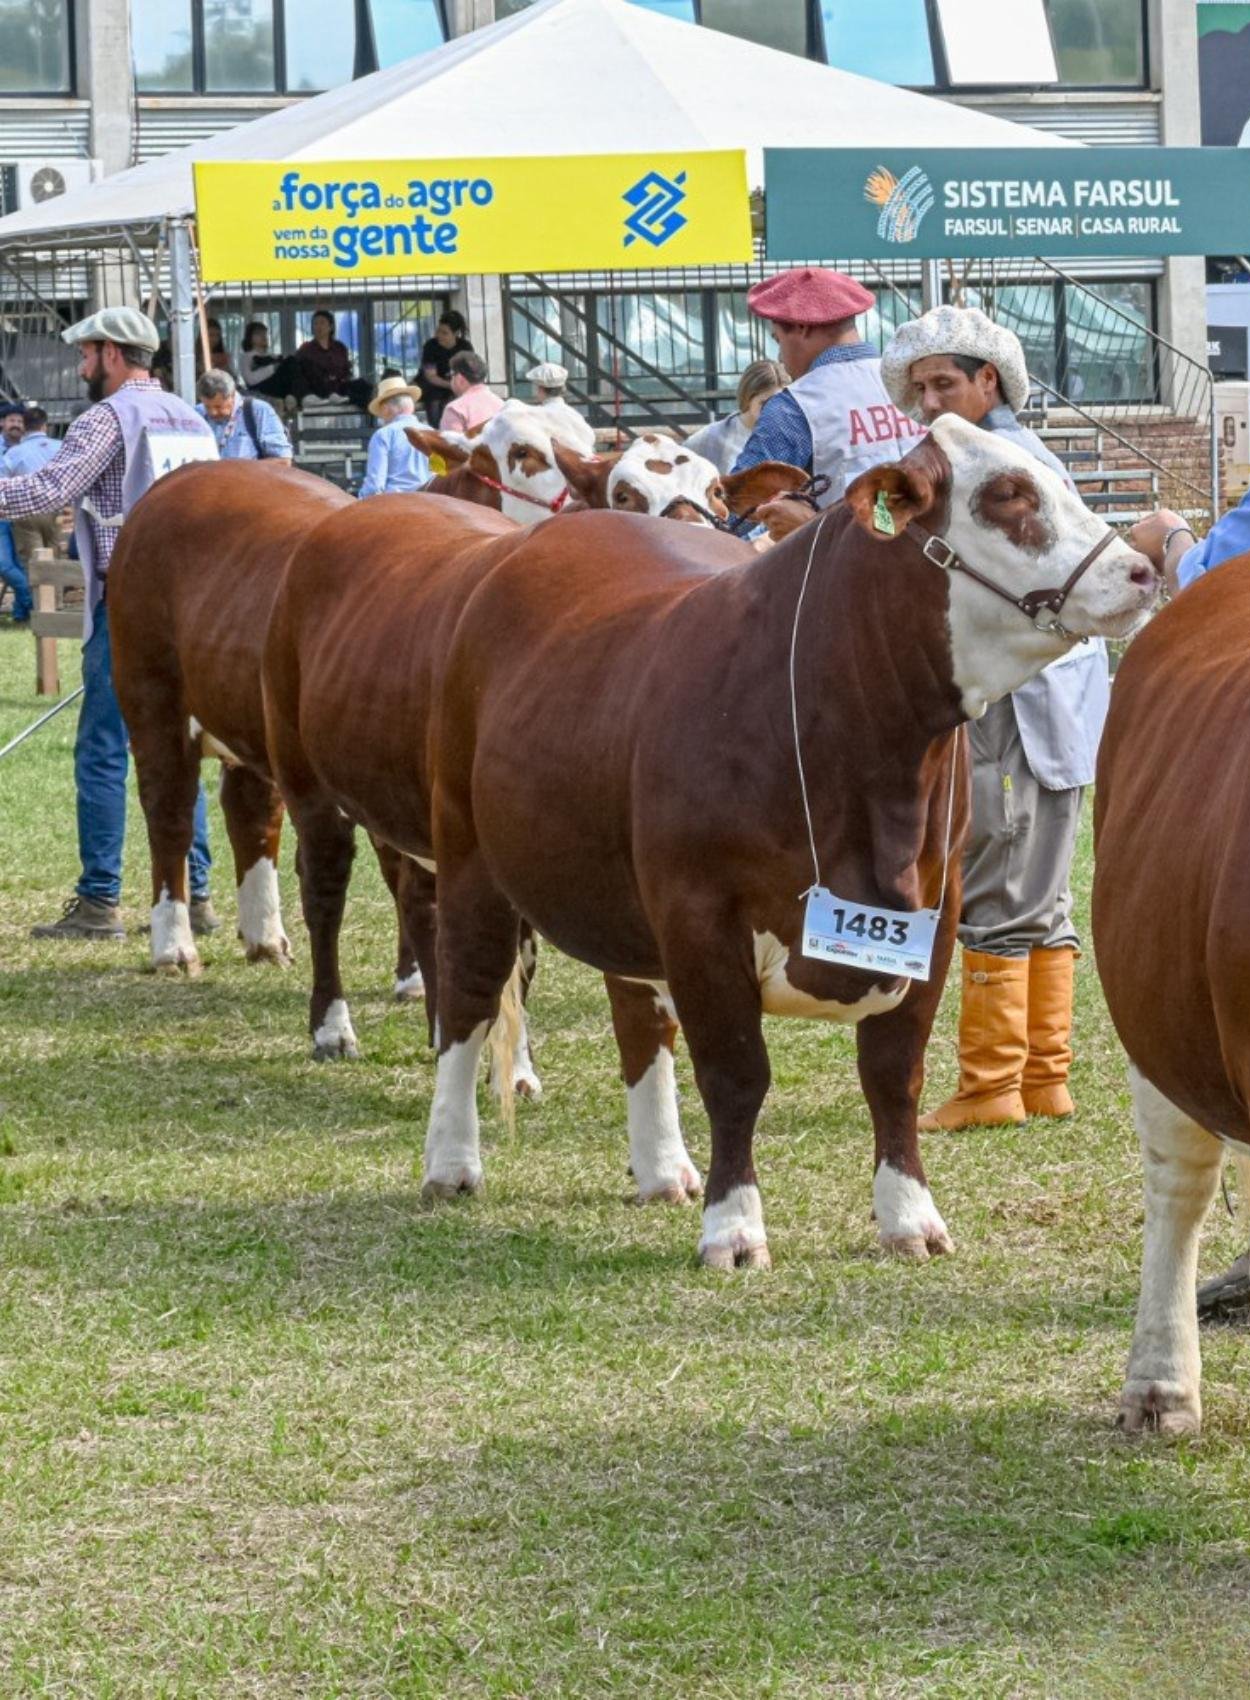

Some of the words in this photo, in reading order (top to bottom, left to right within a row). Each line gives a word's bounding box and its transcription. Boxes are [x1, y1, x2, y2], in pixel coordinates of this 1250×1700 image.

[272, 200, 281, 212] a
[280, 172, 381, 218] força
[384, 194, 405, 209] do
[407, 178, 494, 216] agro
[943, 180, 1068, 208] SISTEMA
[1073, 179, 1180, 207] FARSUL
[273, 228, 307, 241] vem
[309, 226, 328, 240] da
[274, 243, 330, 259] nossa
[332, 214, 458, 269] gente
[944, 218, 1008, 236] FARSUL
[1015, 217, 1073, 236] SENAR
[1080, 216, 1125, 234] CASA
[1127, 216, 1182, 234] RURAL
[849, 403, 928, 446] ABH
[832, 908, 909, 946] 1483
